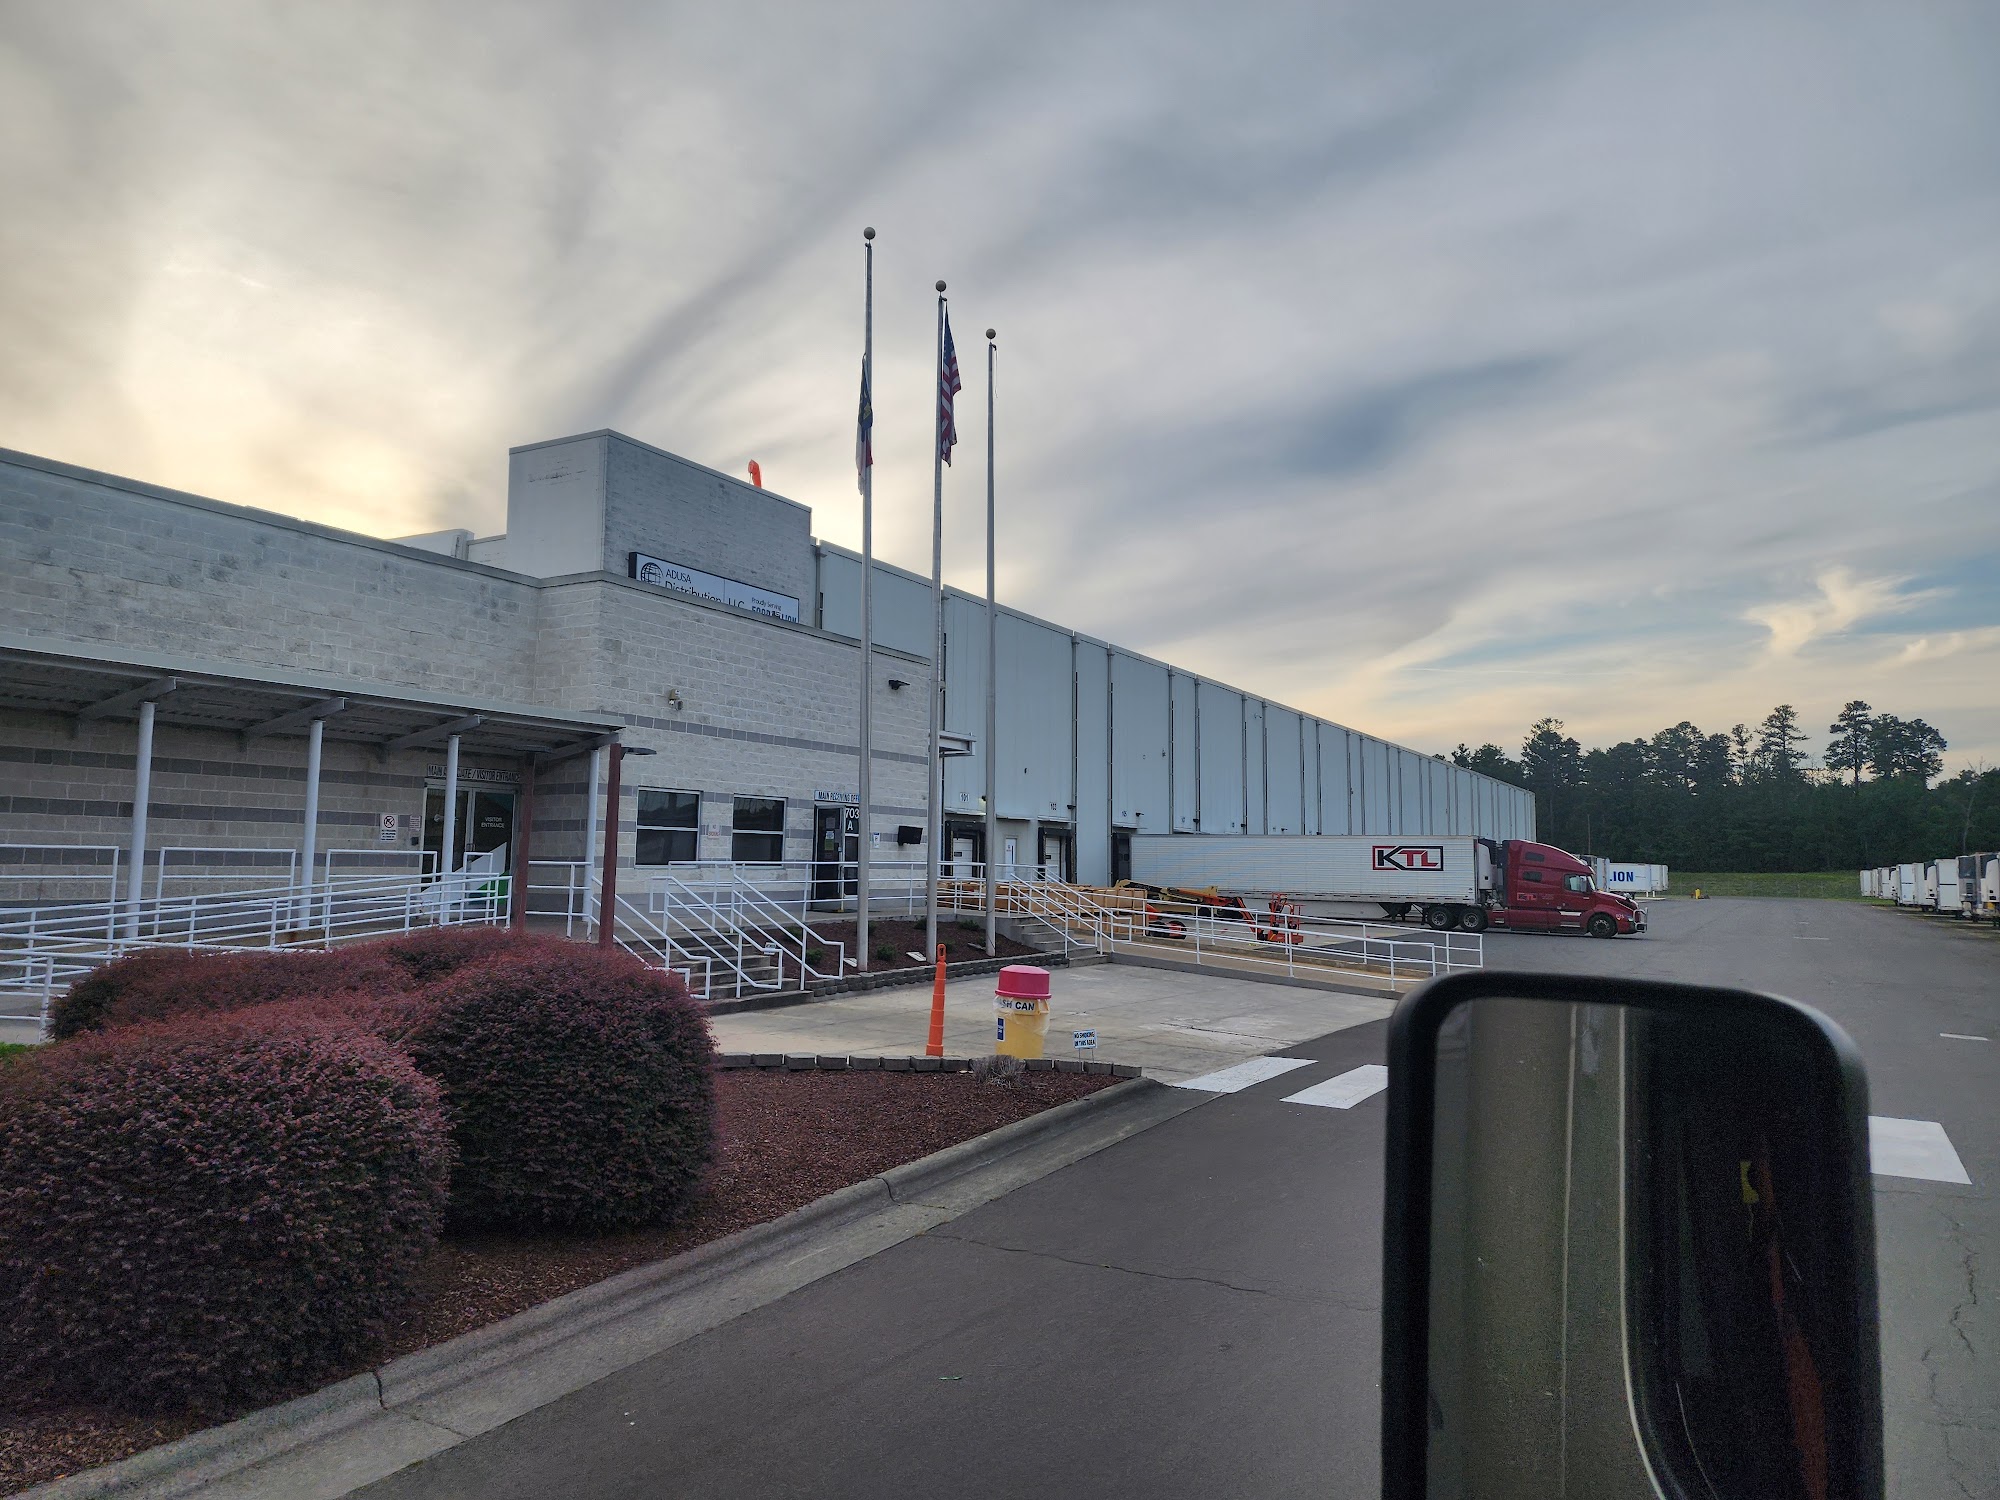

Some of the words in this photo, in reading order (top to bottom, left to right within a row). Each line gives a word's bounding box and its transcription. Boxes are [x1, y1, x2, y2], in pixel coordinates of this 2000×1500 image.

[665, 569, 691, 584] ADUSA
[752, 597, 766, 606] Proudly
[846, 808, 859, 818] 703
[847, 820, 853, 830] A
[1376, 847, 1440, 870] KTL
[1610, 871, 1634, 882] ION
[1015, 1002, 1034, 1010] CAN
